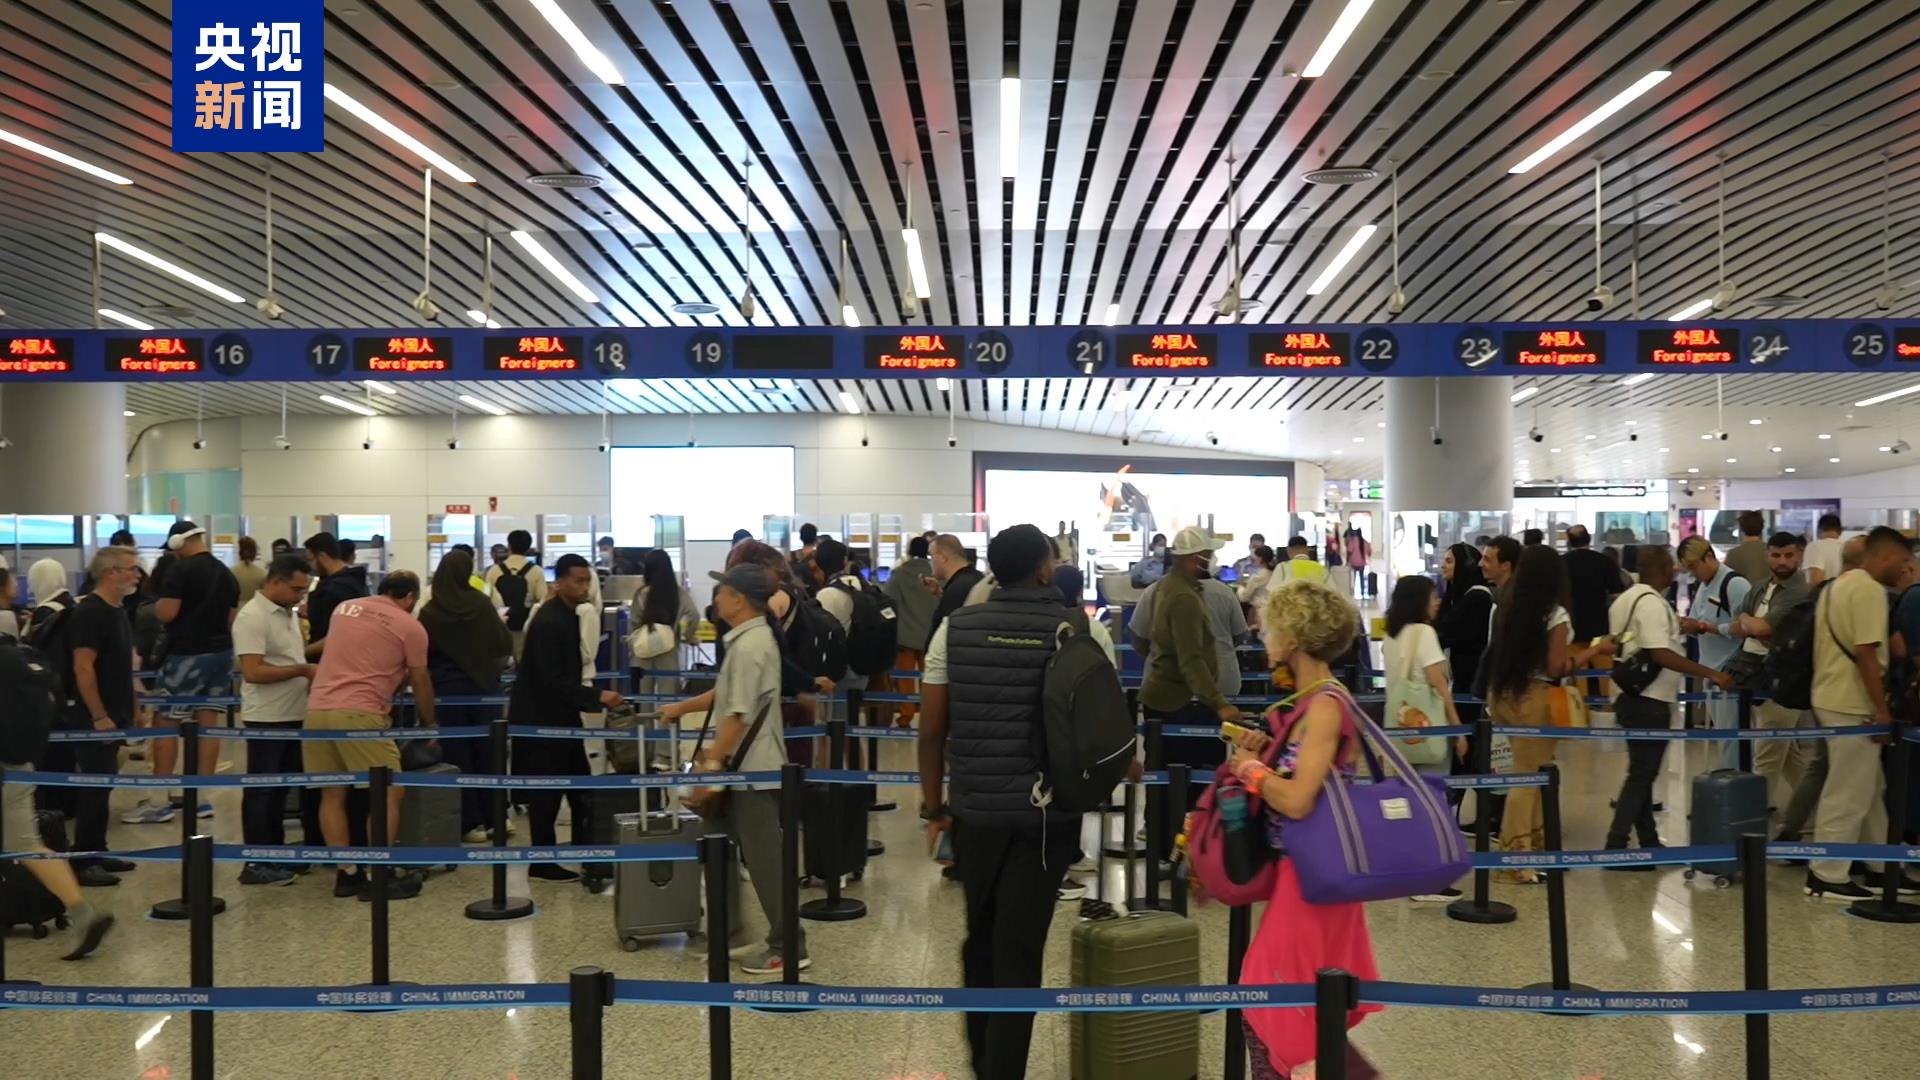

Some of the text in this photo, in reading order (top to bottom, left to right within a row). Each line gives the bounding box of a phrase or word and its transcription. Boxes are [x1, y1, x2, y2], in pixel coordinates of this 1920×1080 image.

[388, 338, 433, 353] 外国人
[519, 337, 564, 352] 外国人
[900, 336, 944, 351] 外国人
[1152, 335, 1197, 350] 外国人
[1285, 334, 1330, 349] 外国人
[1539, 332, 1585, 347] 外国人
[1674, 330, 1720, 346] 外国人
[1752, 336, 1782, 355] 24
[1852, 336, 1883, 355] 25
[10, 339, 55, 354] 外国人
[140, 339, 185, 354] 外国人
[596, 343, 624, 363] 18
[693, 343, 721, 362] 19
[976, 342, 1006, 362] 20
[1076, 342, 1104, 361] 21
[1362, 340, 1392, 359] 22
[1461, 338, 1491, 358] 23
[216, 345, 243, 364] 16
[313, 345, 340, 364] 17
[880, 355, 957, 369] Foreigners
[1132, 354, 1208, 368] Foreigners
[1265, 353, 1341, 367] Foreigners
[1520, 351, 1596, 365] Foreigners
[1654, 350, 1731, 363] Foreigners
[0, 359, 67, 371] oreigners
[121, 358, 196, 371] Foreigners
[370, 357, 445, 371] Foreigners
[500, 356, 576, 370] Foreigners
[86, 992, 124, 1004] CHINA
[128, 992, 208, 1004] IMMIGRATION
[400, 991, 439, 1002] CHINA
[443, 990, 526, 1001] IMMIGRATION
[818, 992, 857, 1003] CHINA
[861, 992, 943, 1005] IMMIGRATION
[1141, 992, 1180, 1004] CHINA
[1185, 990, 1268, 1002] IMMIGRATION
[1562, 996, 1601, 1008] CHINA
[1605, 997, 1688, 1009] IMMIGRATION
